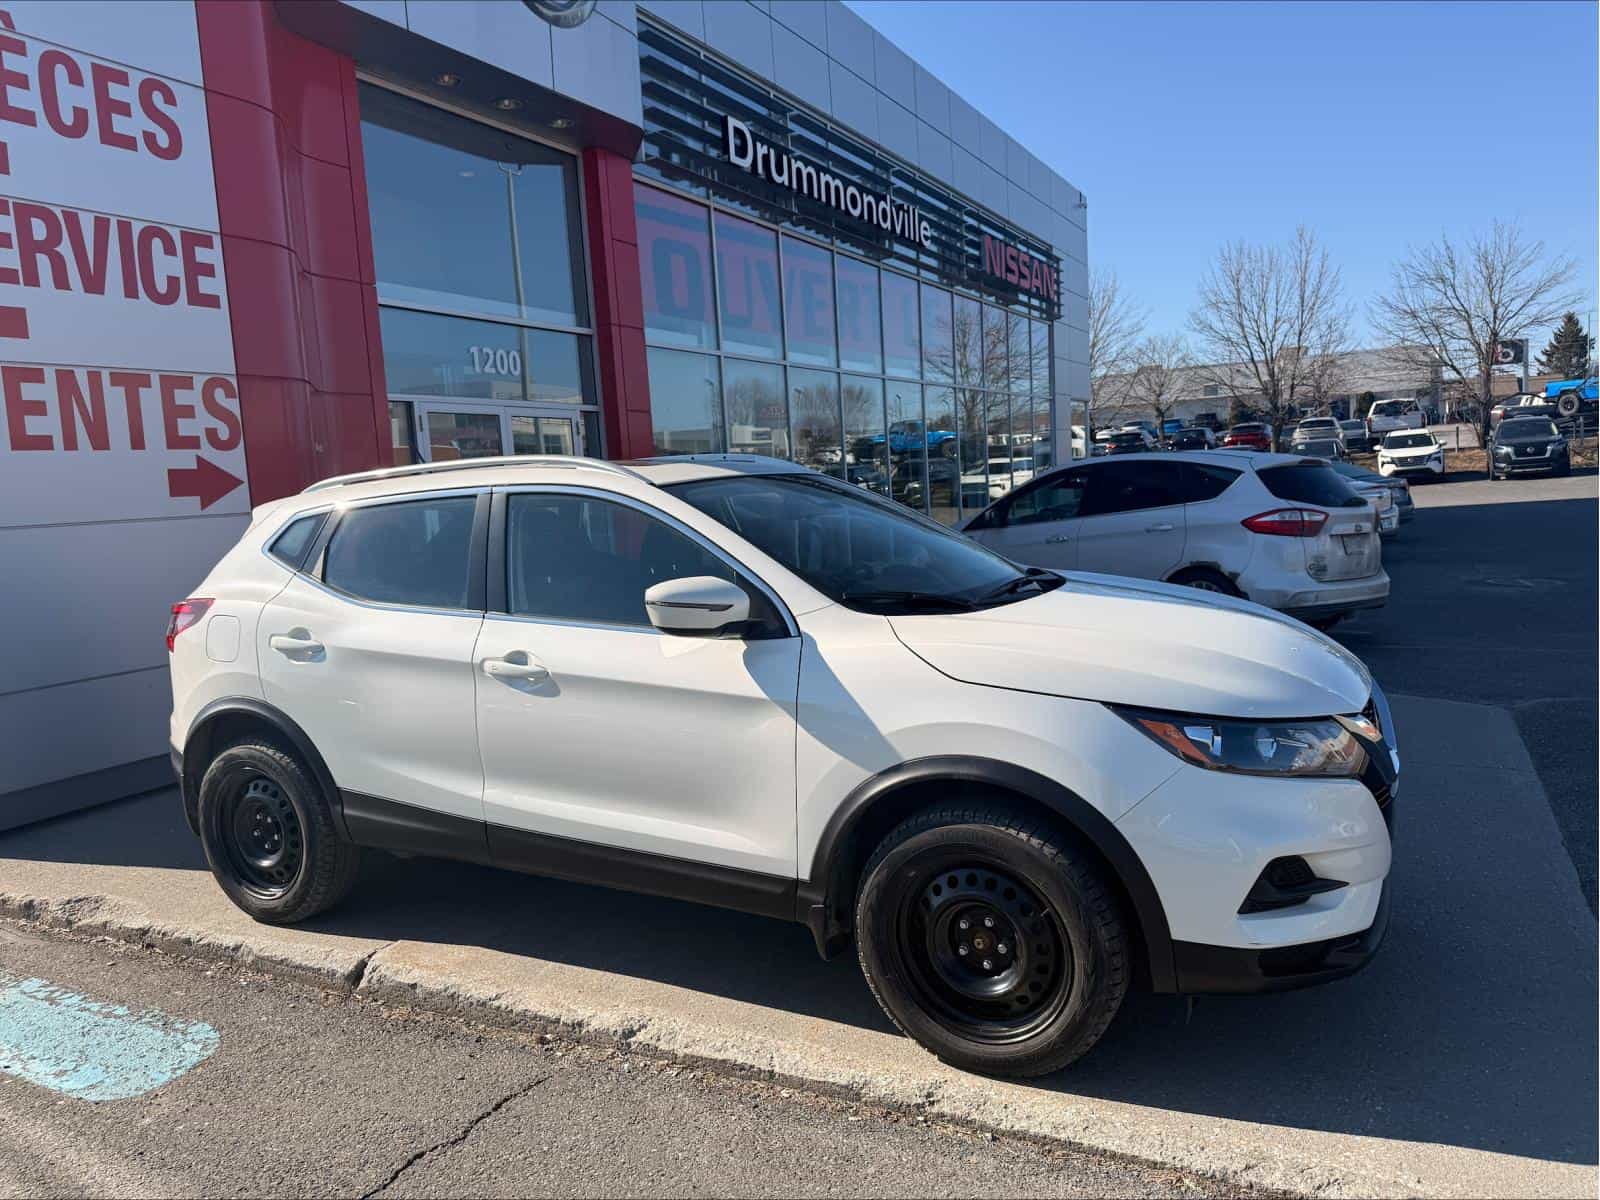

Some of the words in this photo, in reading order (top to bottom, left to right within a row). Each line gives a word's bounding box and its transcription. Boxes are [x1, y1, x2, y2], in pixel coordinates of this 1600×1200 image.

[727, 116, 932, 247] Drummondville
[984, 234, 1056, 301] NISSAN
[470, 346, 521, 376] 1200
[1, 365, 241, 451] ENTES
